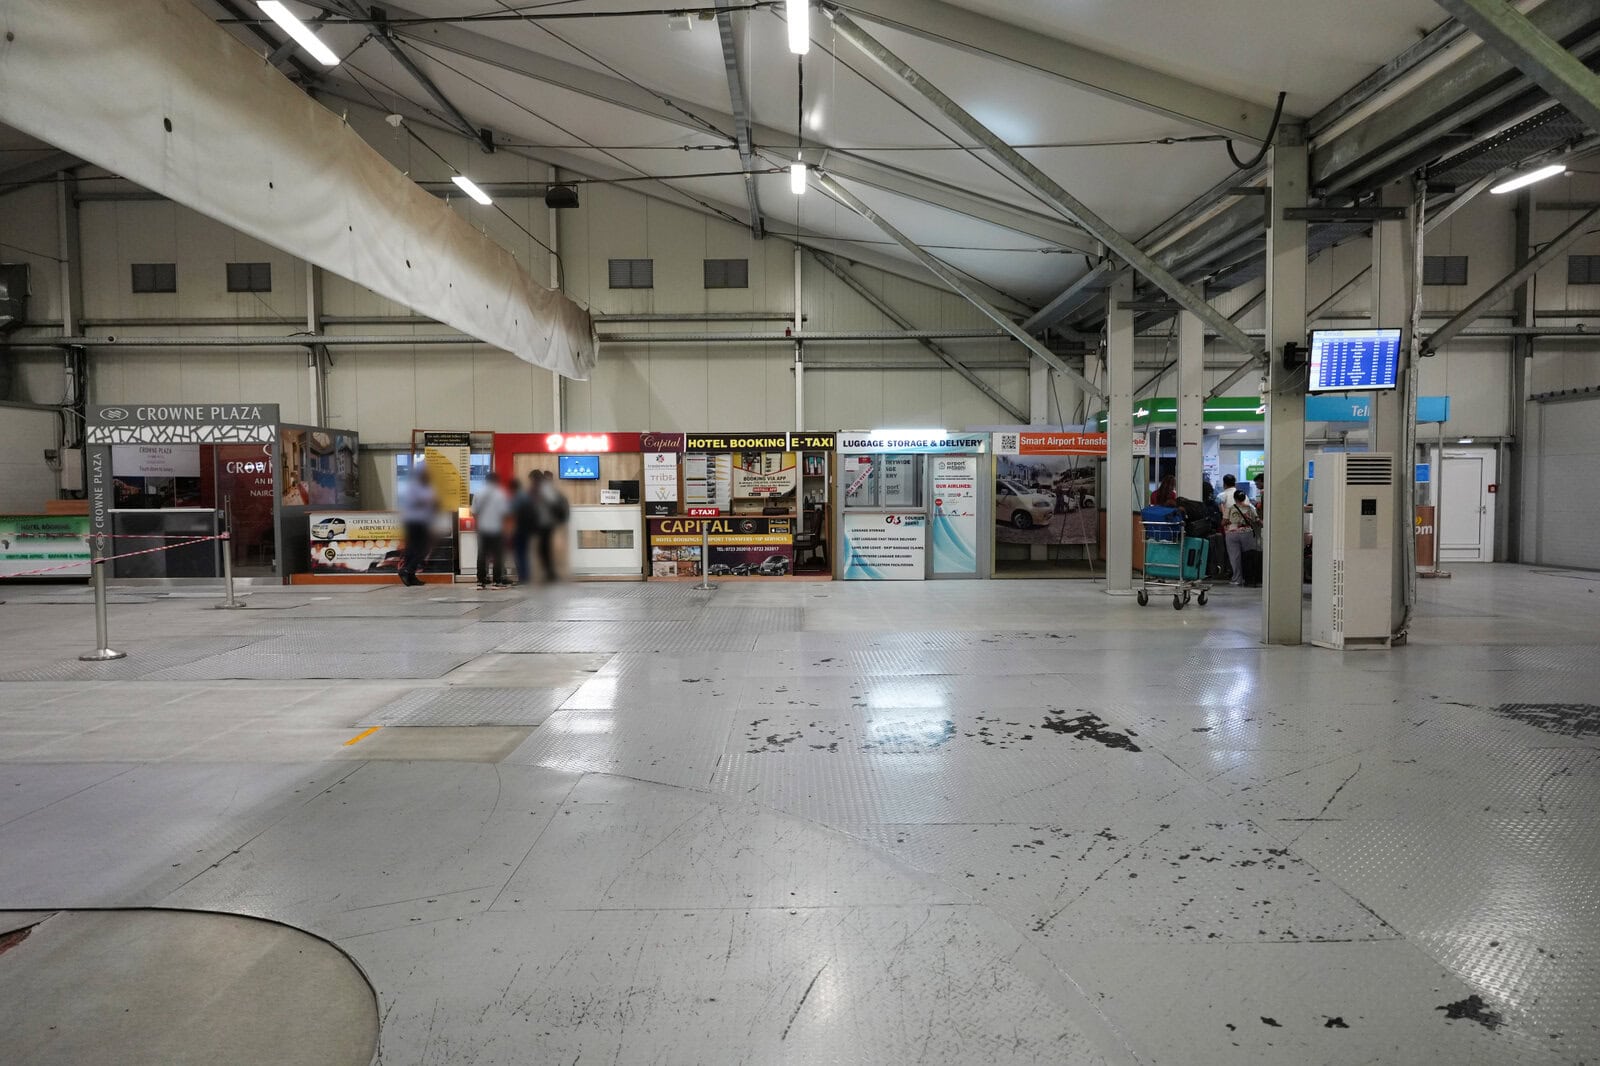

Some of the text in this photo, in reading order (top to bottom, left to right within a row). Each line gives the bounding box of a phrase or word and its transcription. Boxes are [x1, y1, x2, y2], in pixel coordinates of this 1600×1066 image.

[136, 406, 262, 421] CROWNE PLAZA
[641, 435, 681, 451] Capital
[688, 438, 786, 448] HOTEL BOOKING
[791, 438, 834, 447] E-TAXI
[842, 440, 885, 448] LUGGAGE
[887, 440, 928, 448] STORAGE
[939, 439, 983, 447] DELIVERY
[1020, 436, 1046, 446] Smart
[1048, 436, 1076, 448] Airport
[94, 452, 104, 530] CROWNE PLAZA
